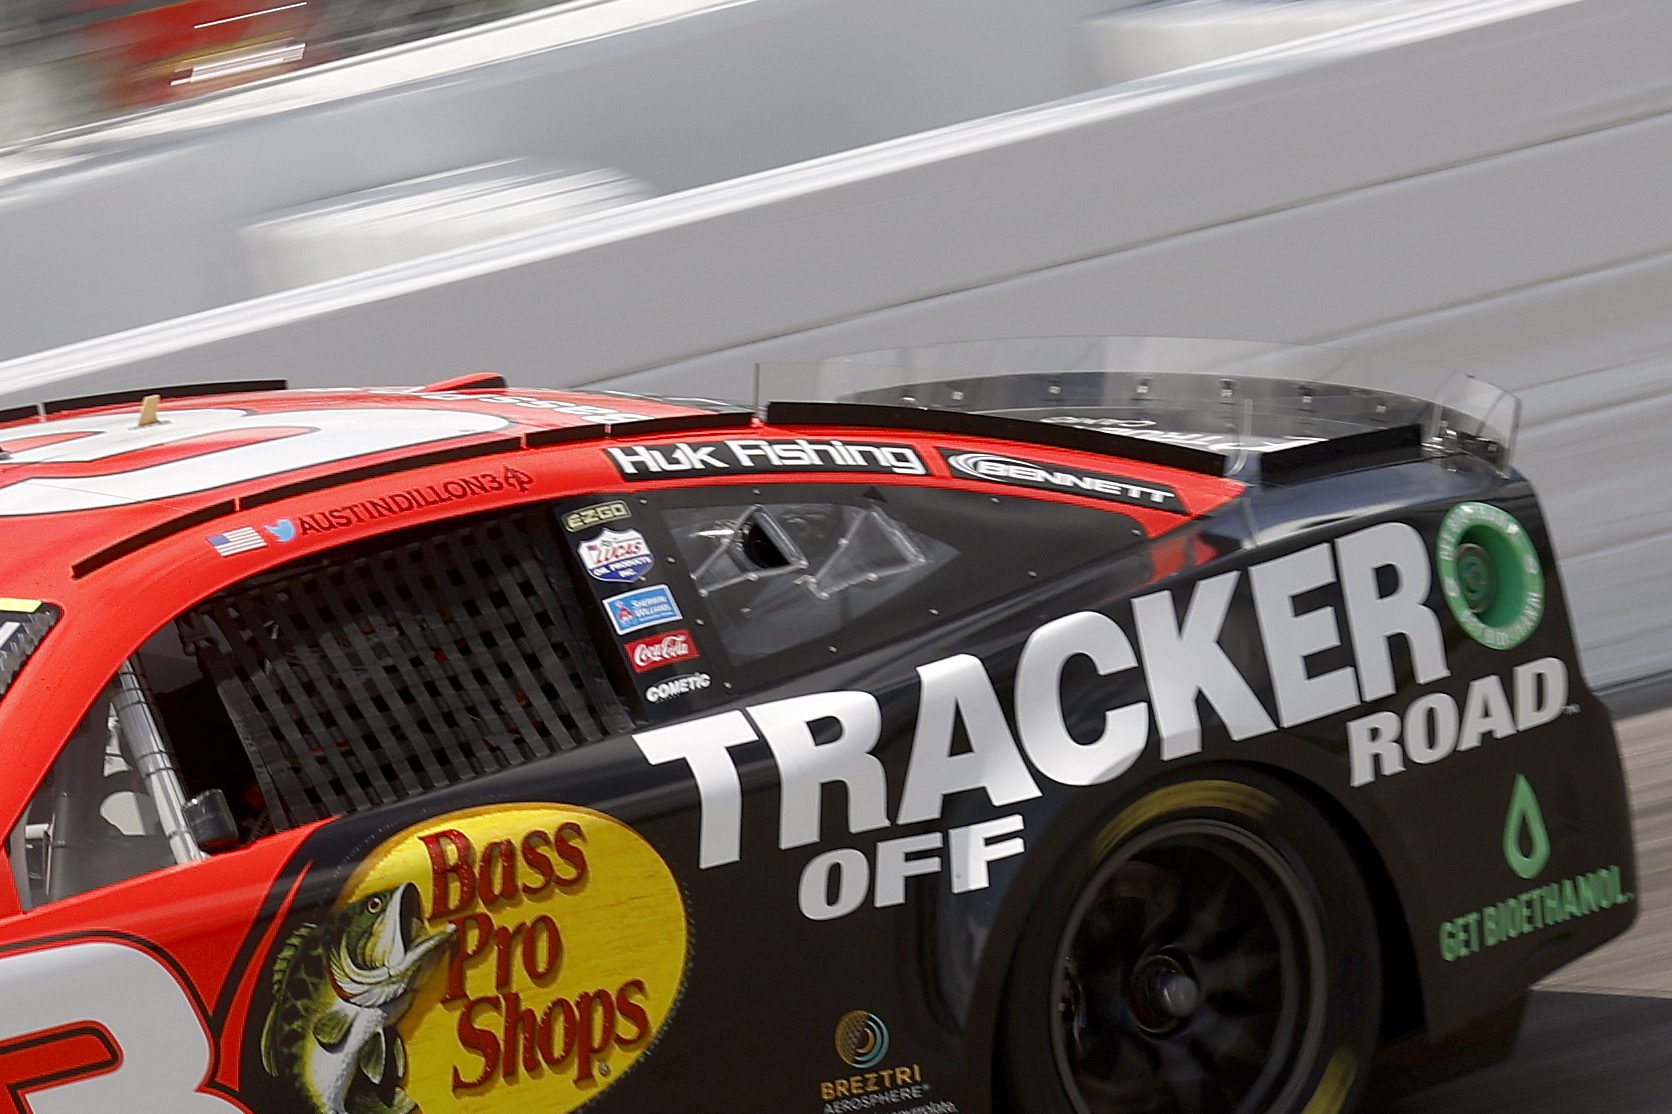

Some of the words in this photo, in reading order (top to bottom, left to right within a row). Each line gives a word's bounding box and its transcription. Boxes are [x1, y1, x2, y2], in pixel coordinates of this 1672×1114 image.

[300, 472, 504, 536] AUSTINDILLON3
[619, 442, 730, 477] Huk
[728, 438, 927, 477] Fishing
[977, 461, 1176, 502] BENNETT
[633, 522, 1452, 868] TRACKER
[645, 673, 712, 702] COMETIC
[1345, 657, 1570, 788] ROAD
[418, 821, 588, 920] Bass
[797, 812, 1028, 922] OFF
[1438, 911, 1481, 961] GET
[1481, 865, 1630, 947] BIOETHANOL
[446, 912, 562, 1002] Pro
[451, 978, 650, 1092] Shops
[820, 1064, 922, 1101] BREZTRI
